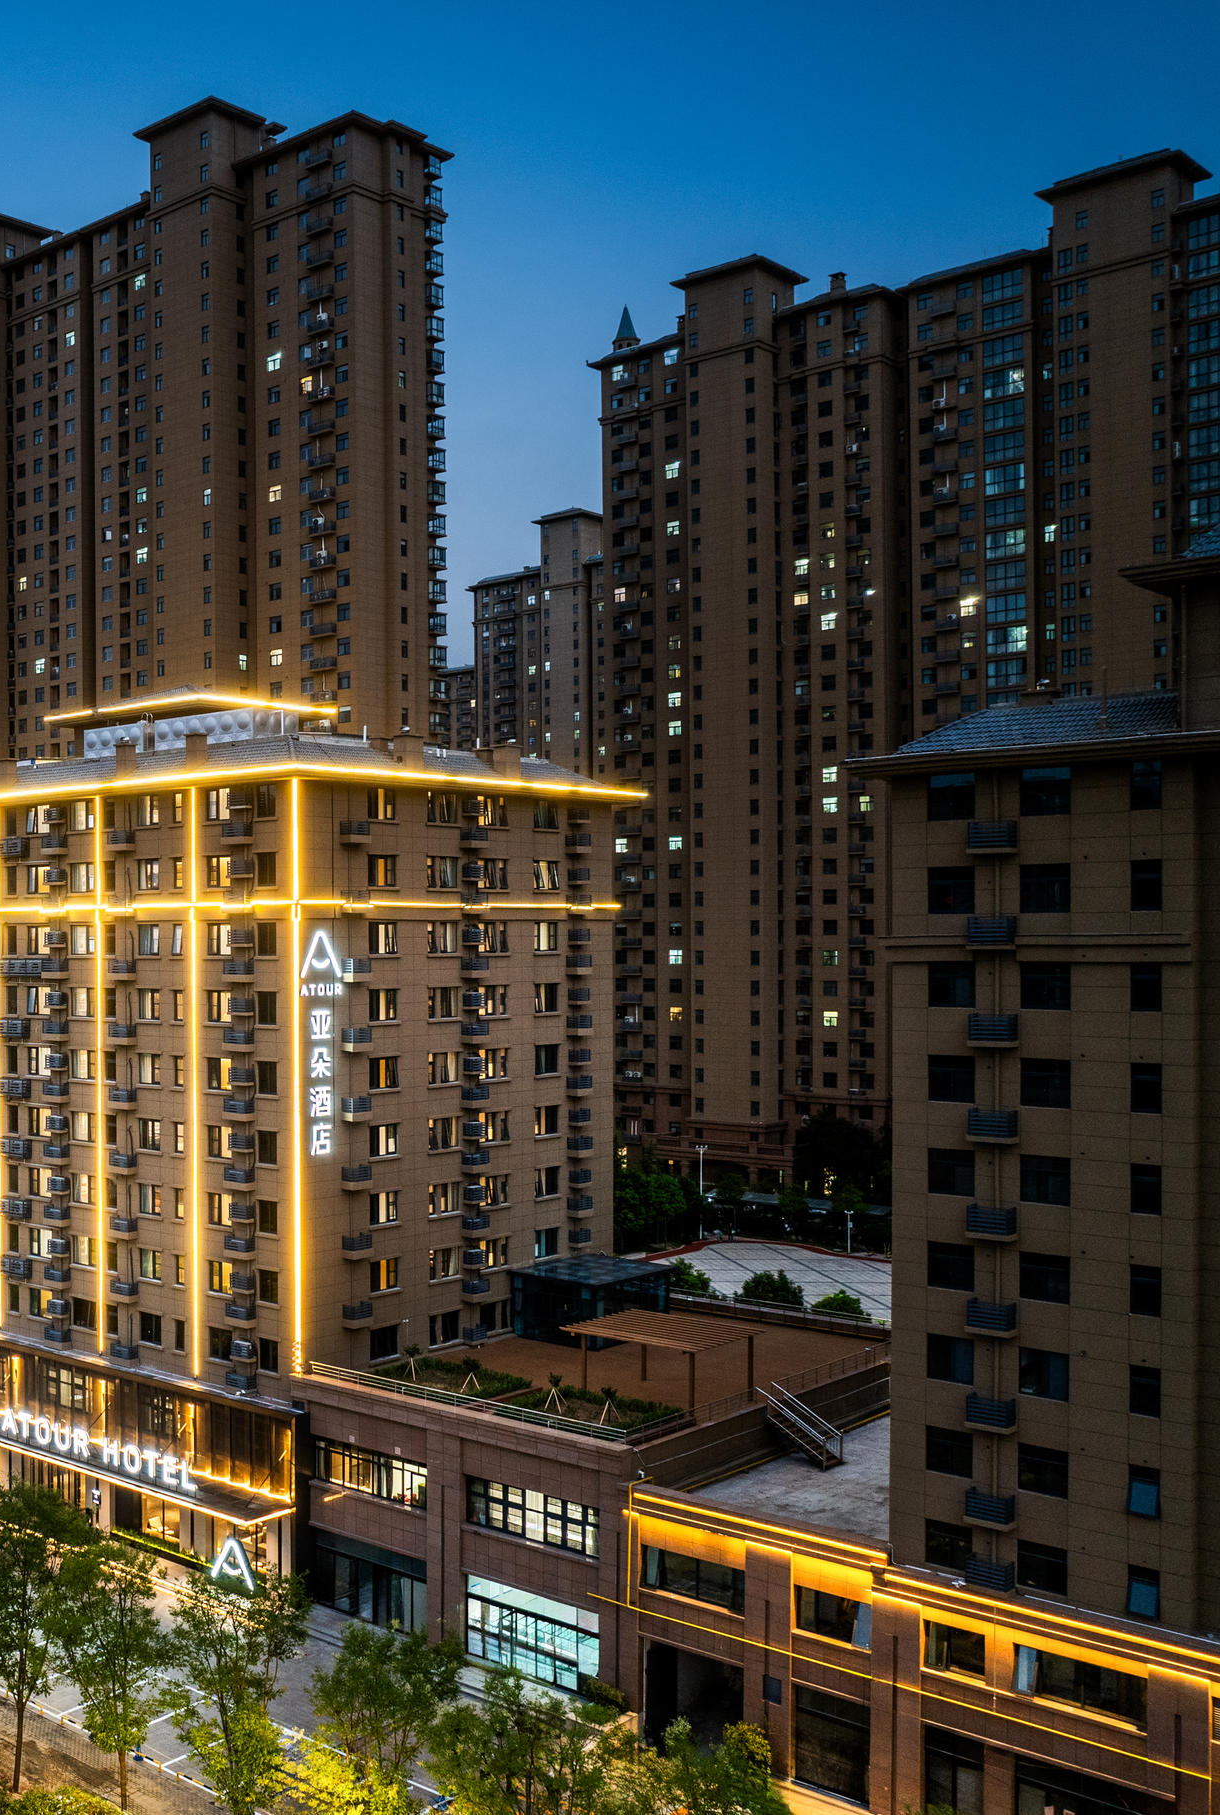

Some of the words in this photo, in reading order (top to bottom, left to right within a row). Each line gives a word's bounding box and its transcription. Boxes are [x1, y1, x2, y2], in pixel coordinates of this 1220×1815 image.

[300, 983, 343, 997] ATOUR
[309, 1009, 332, 1157] 亚朵酒店
[1, 1408, 91, 1459] ATOUR
[102, 1436, 198, 1491] HOTEL
